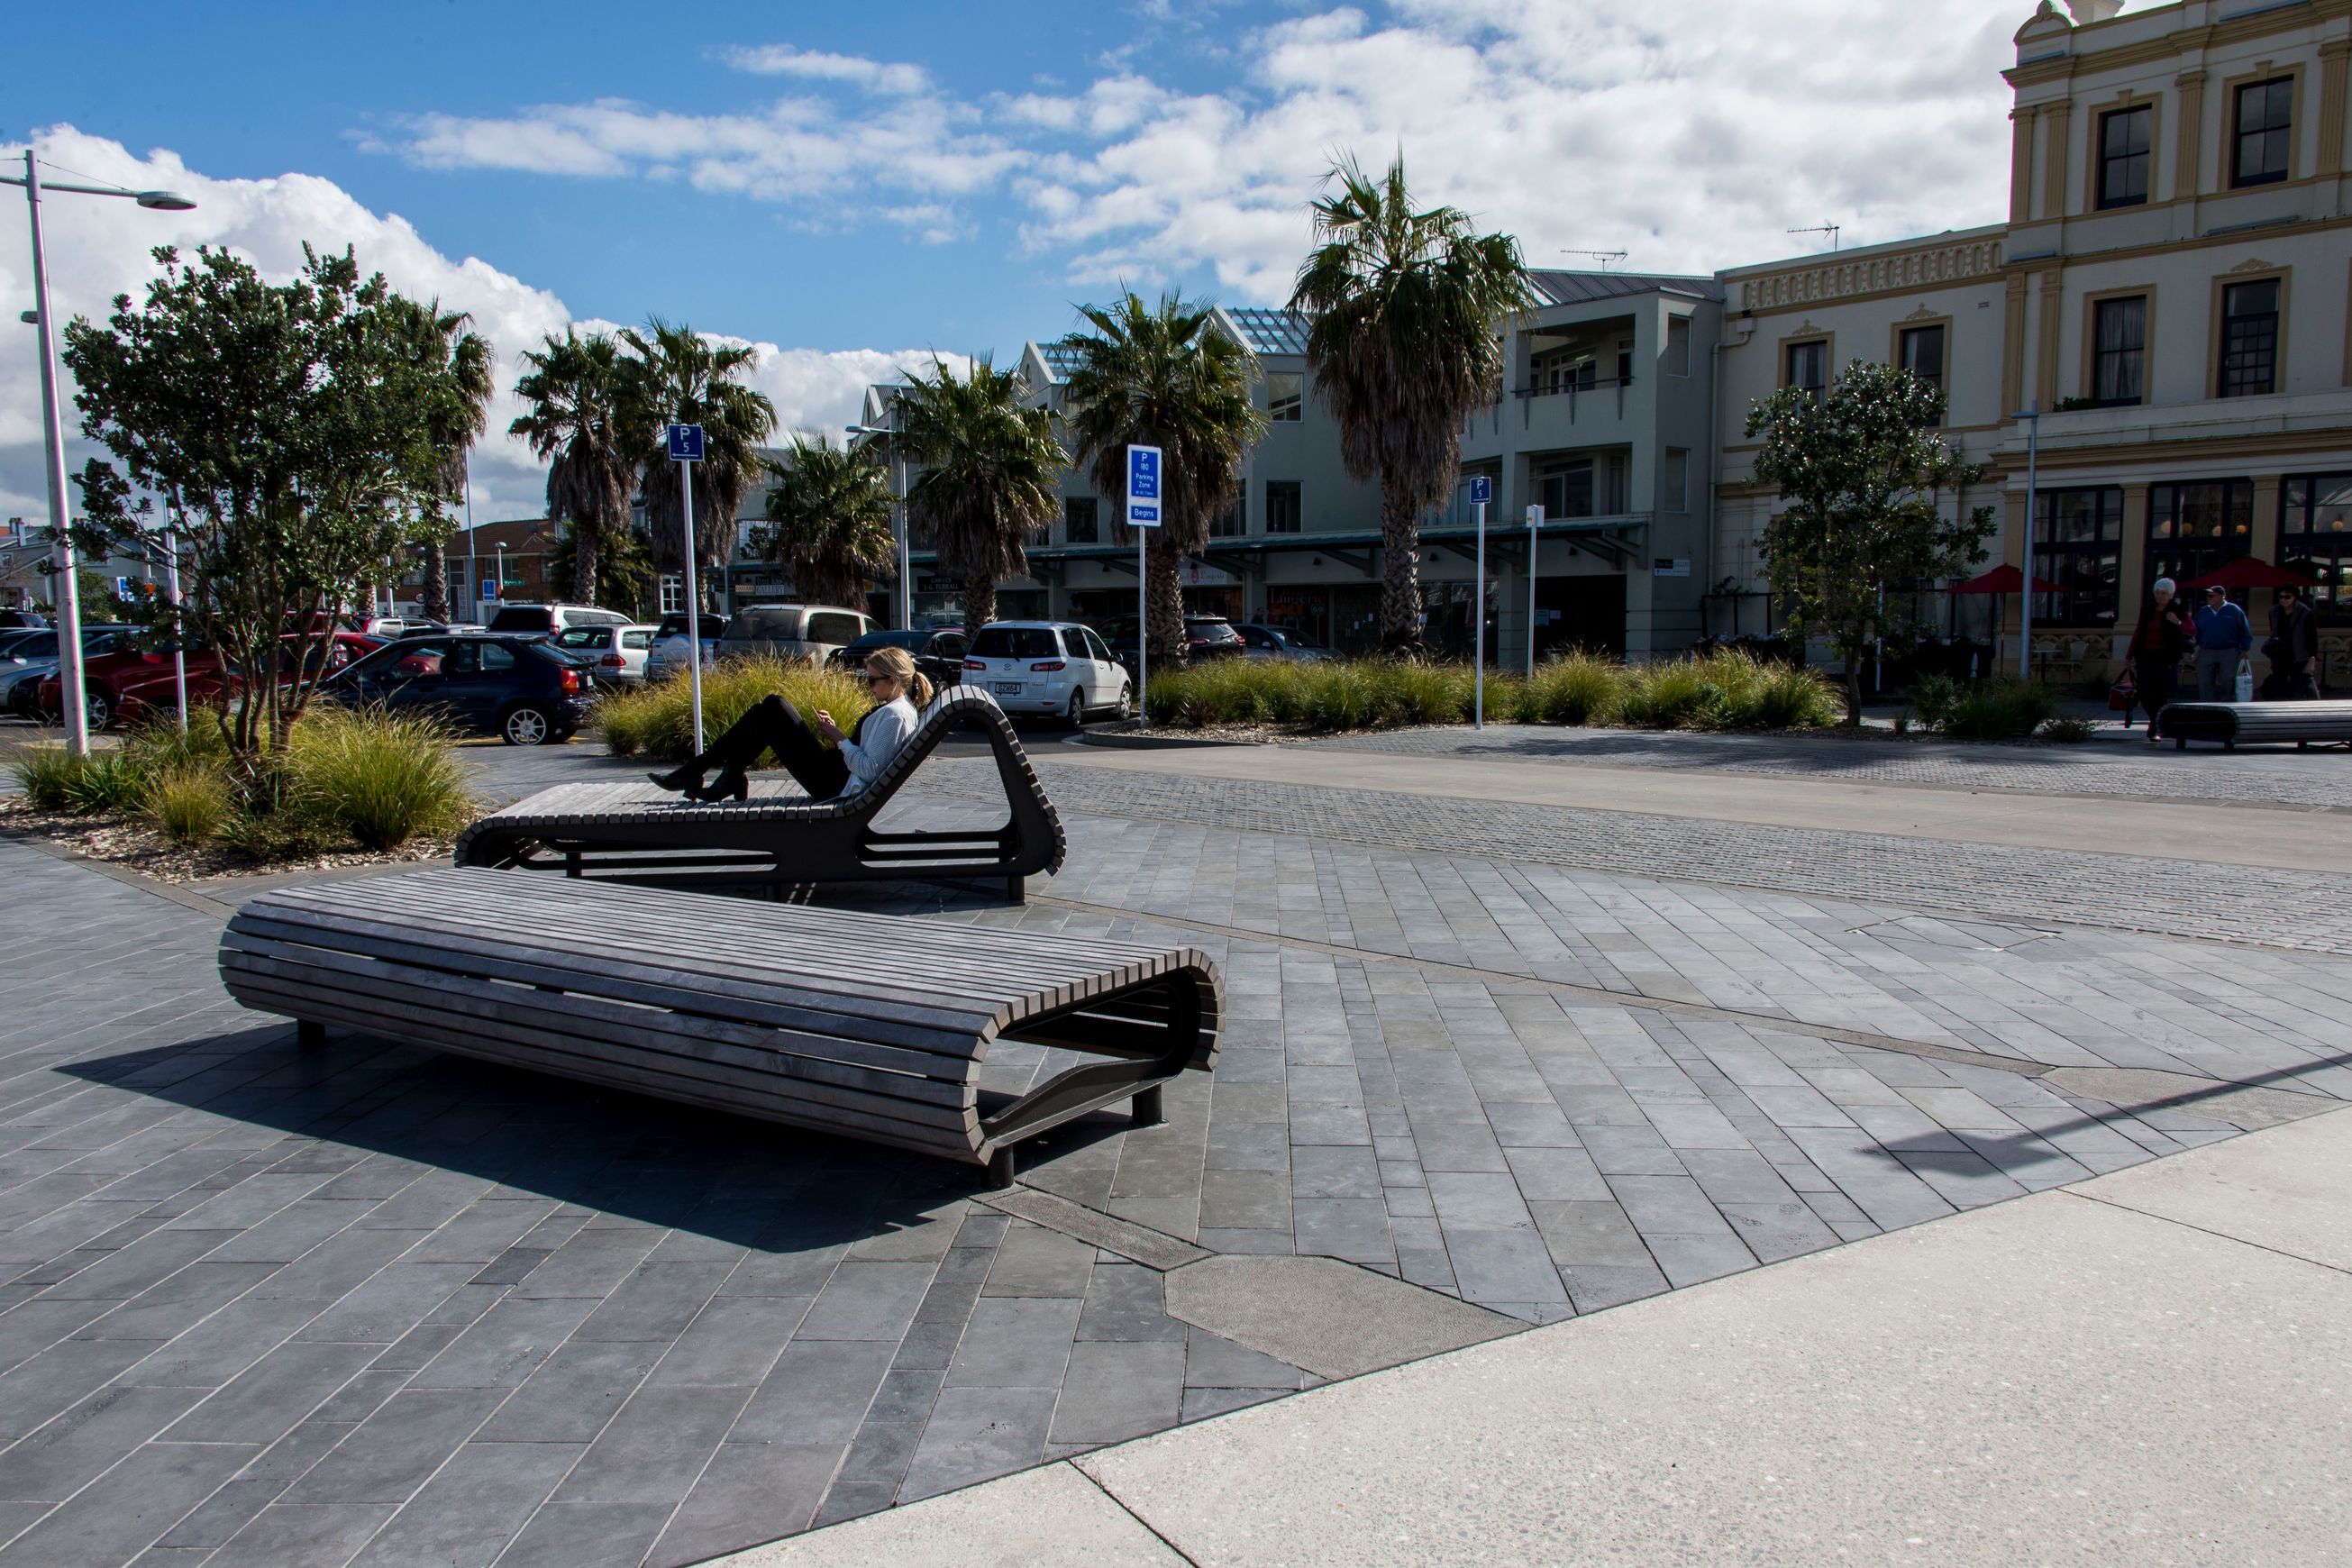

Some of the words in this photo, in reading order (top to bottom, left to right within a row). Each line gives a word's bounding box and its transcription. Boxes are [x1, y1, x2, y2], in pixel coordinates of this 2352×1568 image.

[679, 427, 690, 441] P
[683, 442, 689, 452] 5
[1141, 452, 1148, 461] P
[1135, 473, 1153, 482] Parking
[1476, 479, 1483, 489] P
[1478, 489, 1482, 497] 5
[1135, 508, 1153, 518] Begins
